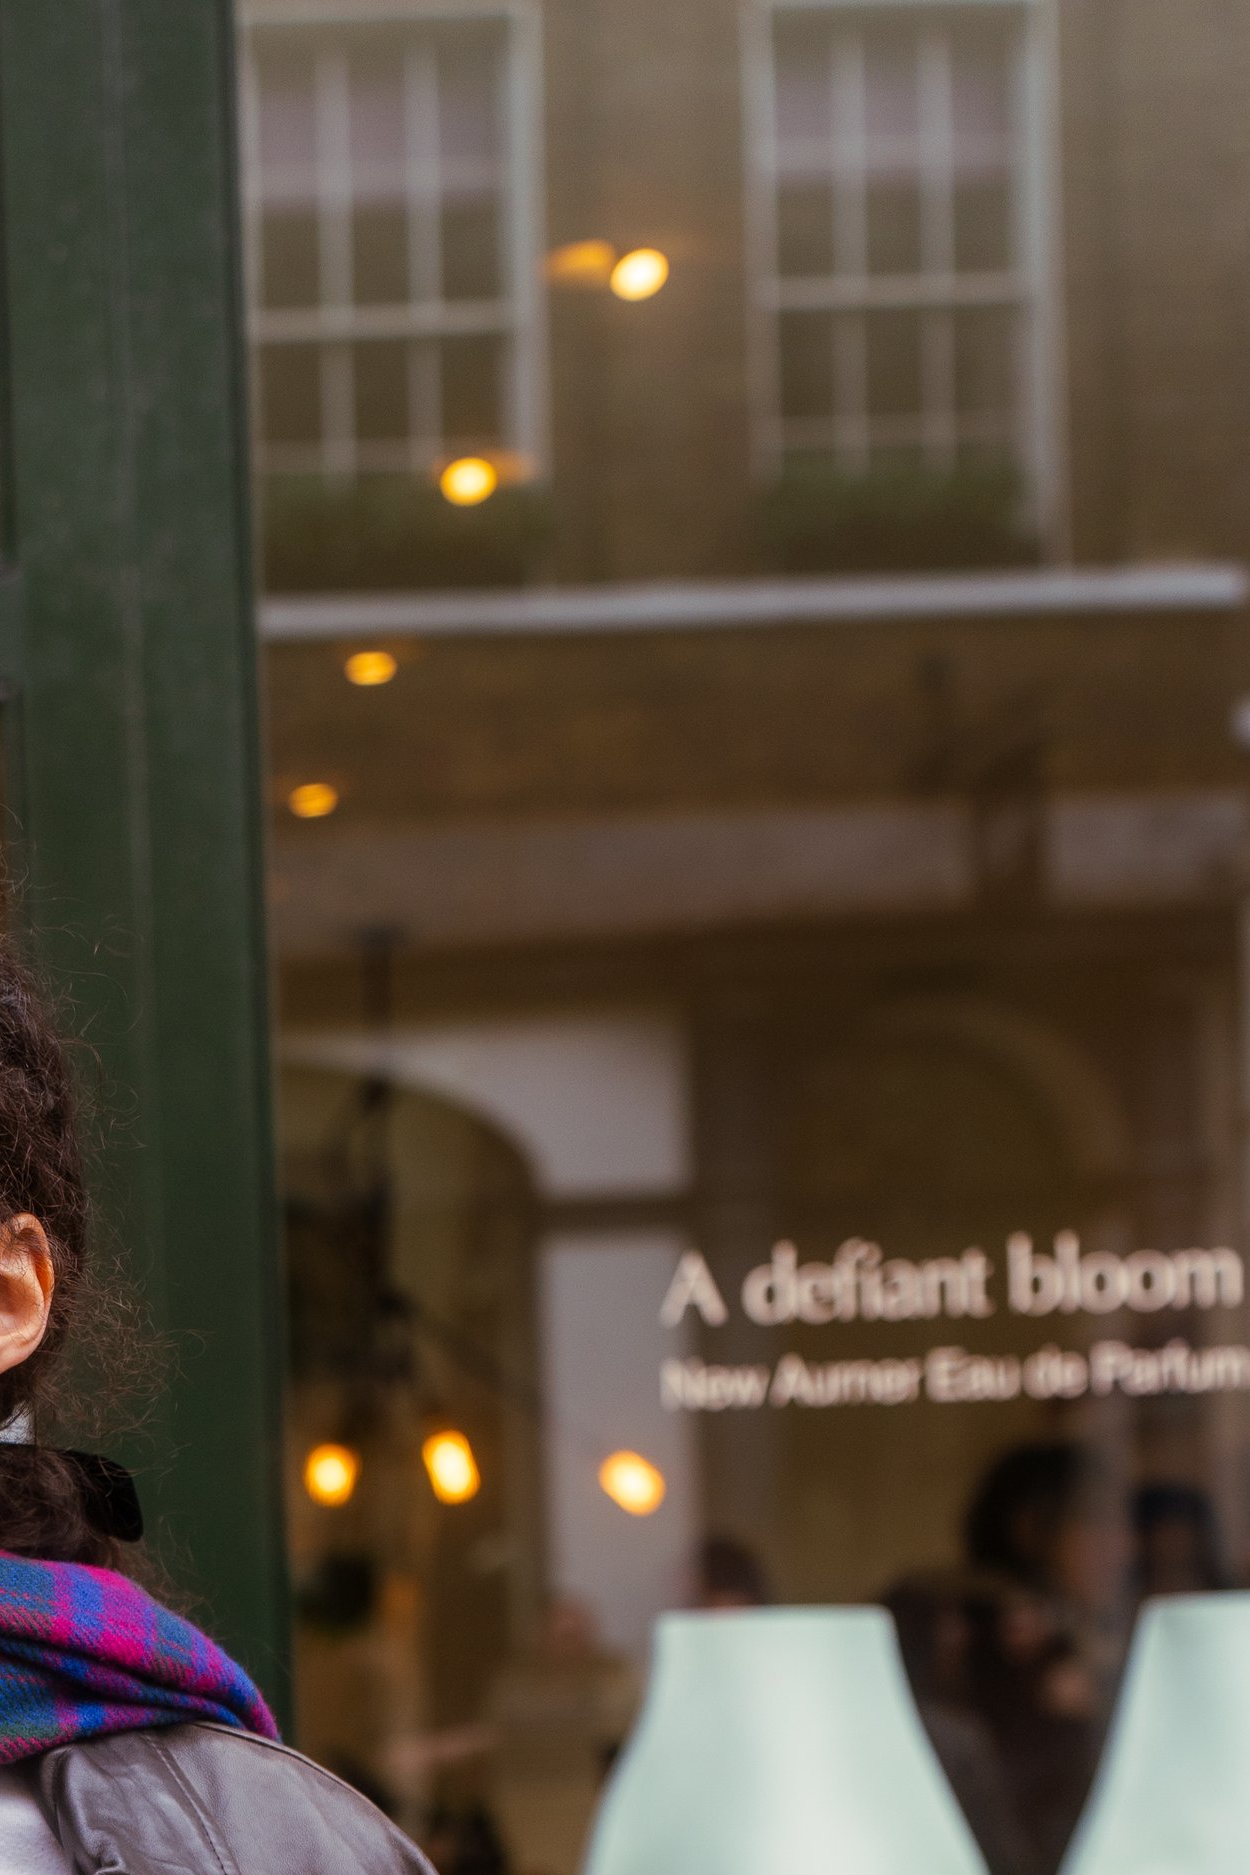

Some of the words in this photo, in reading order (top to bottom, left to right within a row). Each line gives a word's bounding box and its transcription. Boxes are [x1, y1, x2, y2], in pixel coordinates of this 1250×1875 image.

[660, 1250, 729, 1328] A
[741, 1237, 994, 1326] defiant
[1007, 1228, 1244, 1316] bloom
[659, 1356, 769, 1412] New
[925, 1345, 1021, 1403] Eau
[1023, 1342, 1087, 1400] de
